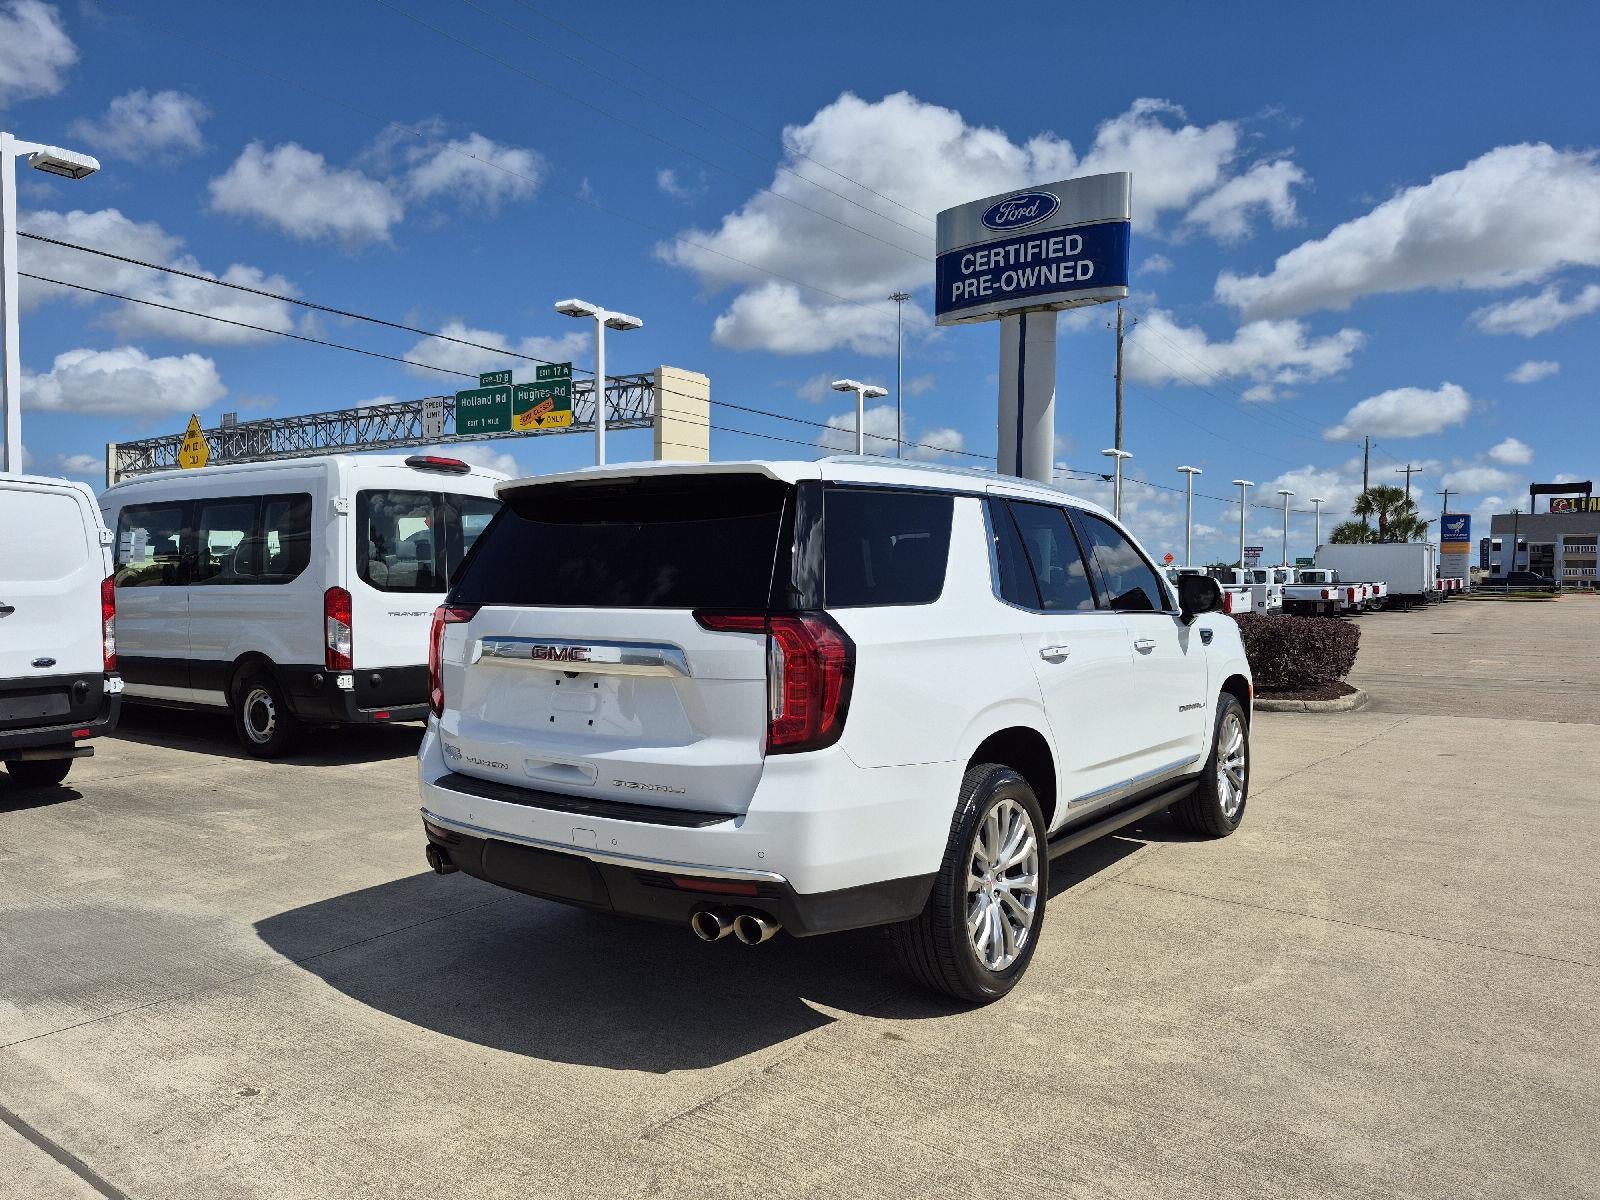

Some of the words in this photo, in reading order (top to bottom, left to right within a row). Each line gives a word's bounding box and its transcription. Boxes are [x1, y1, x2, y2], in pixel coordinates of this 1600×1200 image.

[995, 197, 1041, 224] Ford
[960, 234, 1083, 275] CERTIFIED
[952, 260, 1095, 302] PRE-OWNED
[495, 374, 502, 382] 17
[504, 373, 509, 382] B
[553, 366, 561, 376] 17
[563, 367, 569, 375] A
[461, 394, 492, 407] Holland
[495, 392, 507, 403] Rd
[518, 388, 551, 402] Hughes
[554, 386, 566, 397] Rd
[425, 401, 443, 410] SPEED
[426, 411, 441, 419] LIMIT
[481, 418, 485, 426] 1
[487, 417, 499, 425] MILE
[546, 415, 564, 424] ONLY
[531, 645, 591, 663] GMC
[612, 778, 687, 794] DENALI
